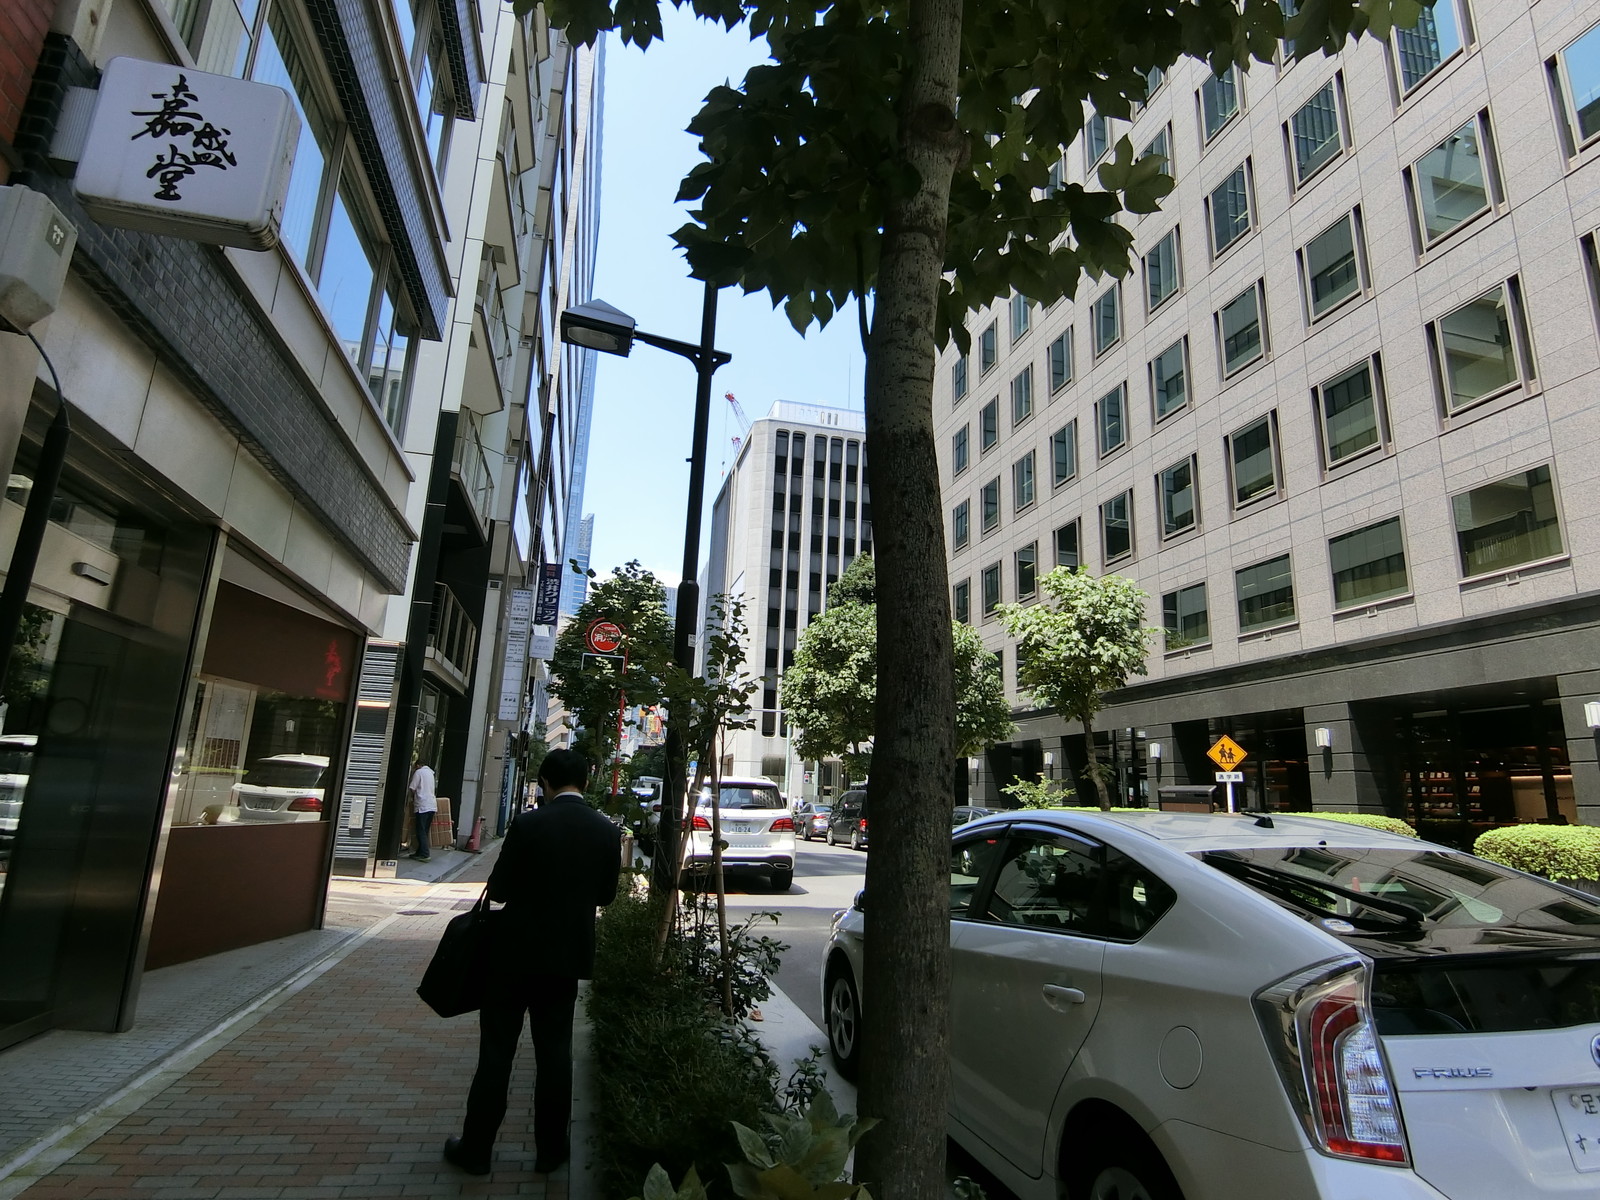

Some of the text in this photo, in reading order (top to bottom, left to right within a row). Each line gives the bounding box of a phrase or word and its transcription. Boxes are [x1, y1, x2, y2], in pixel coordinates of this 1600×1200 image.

[131, 74, 237, 201] 嘉盛堂
[1413, 1067, 1494, 1079] PRIUS
[1581, 1094, 1600, 1115] 足
